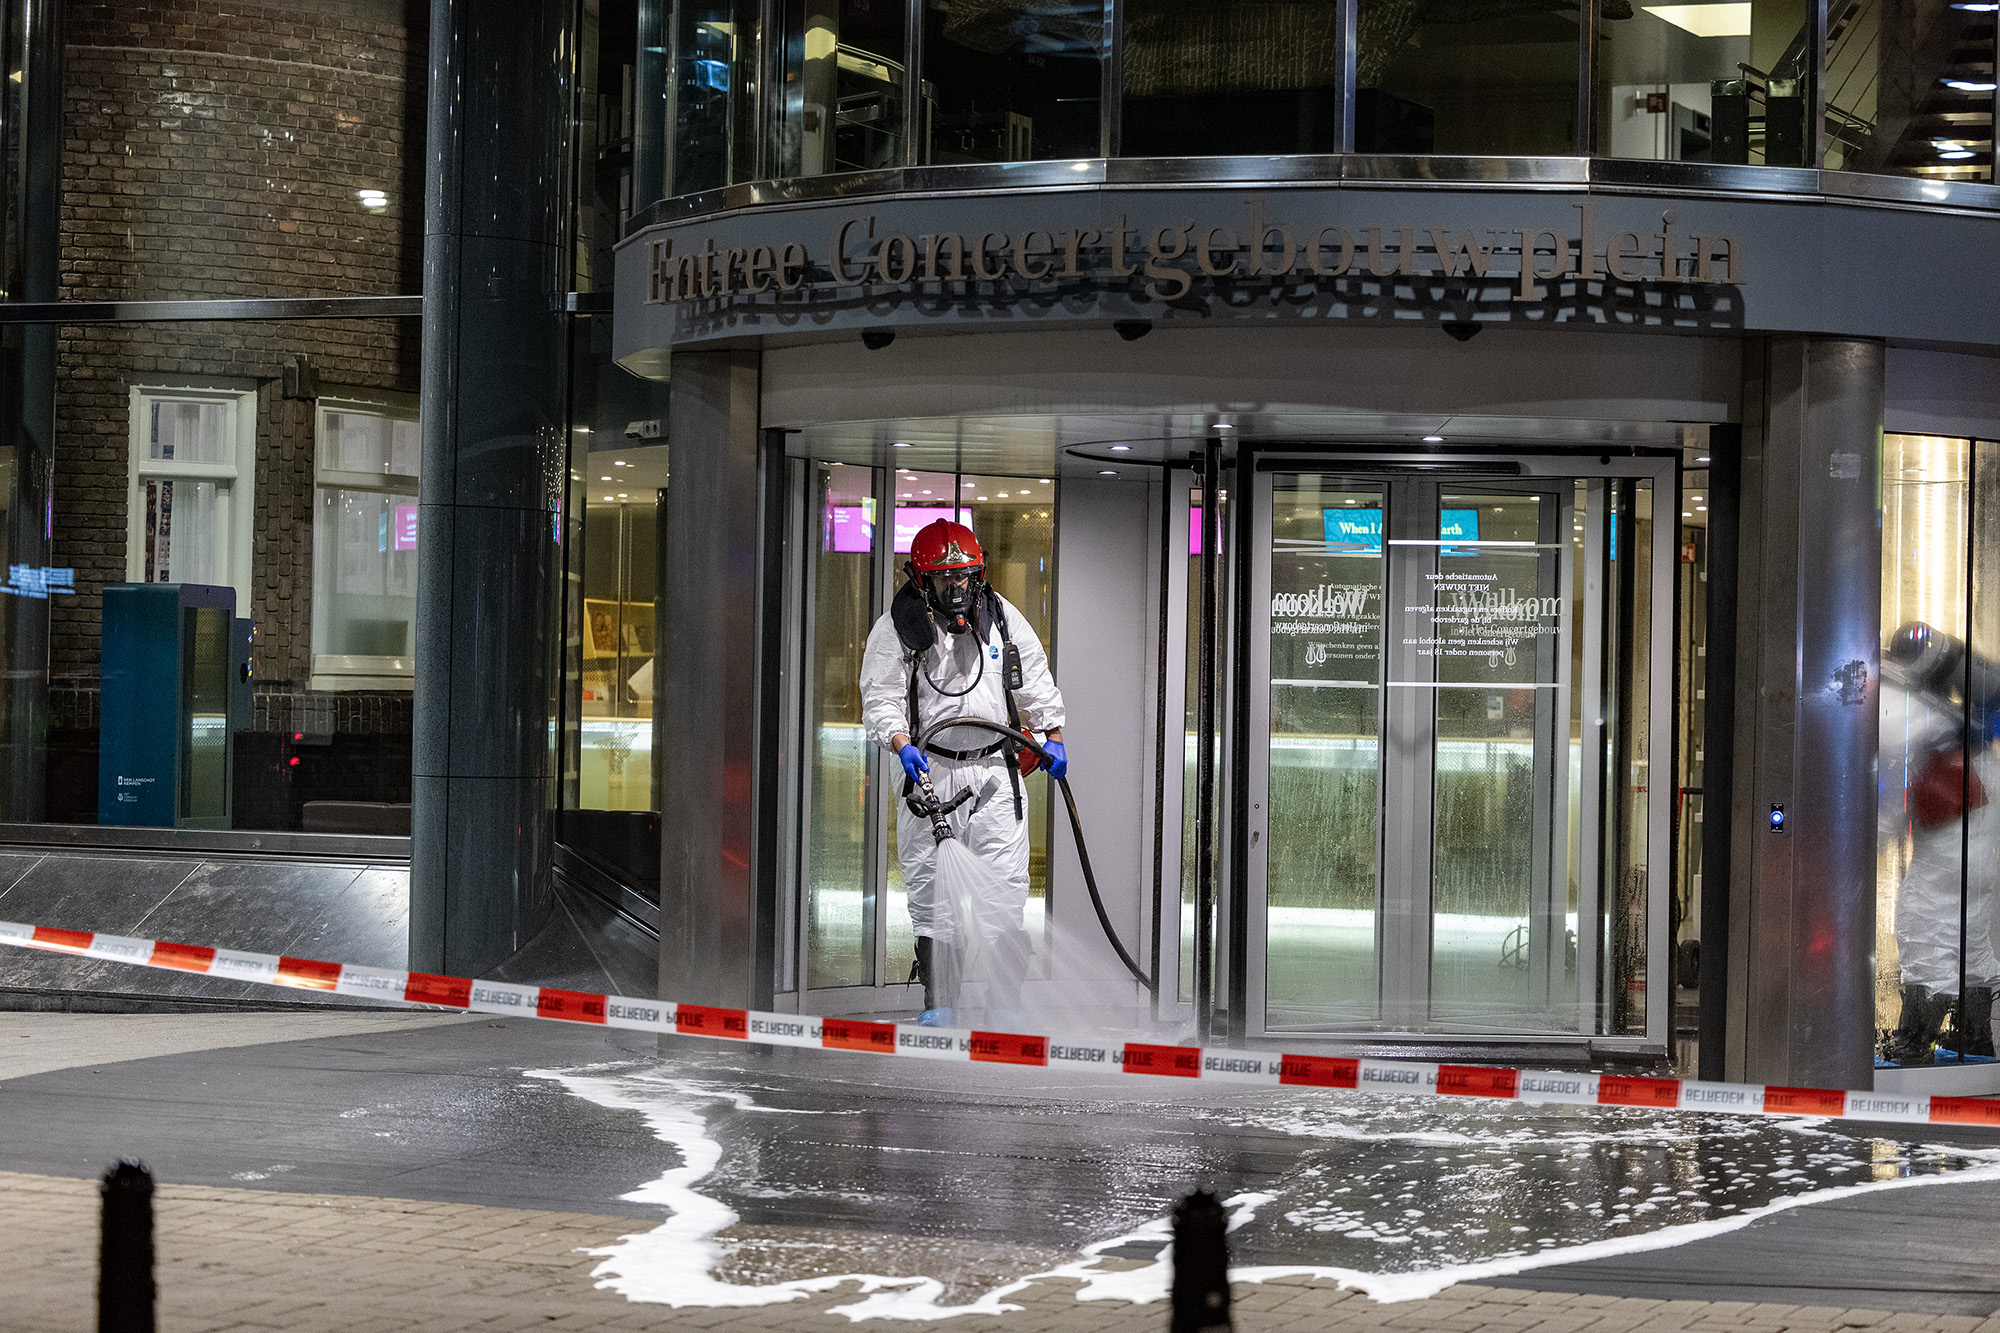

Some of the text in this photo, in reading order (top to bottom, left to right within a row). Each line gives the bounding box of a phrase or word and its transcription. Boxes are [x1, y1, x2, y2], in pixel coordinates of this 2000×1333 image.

[644, 198, 1748, 305] Entree Concertgebouwplein
[1338, 521, 1370, 535] When
[1440, 522, 1463, 536] arth
